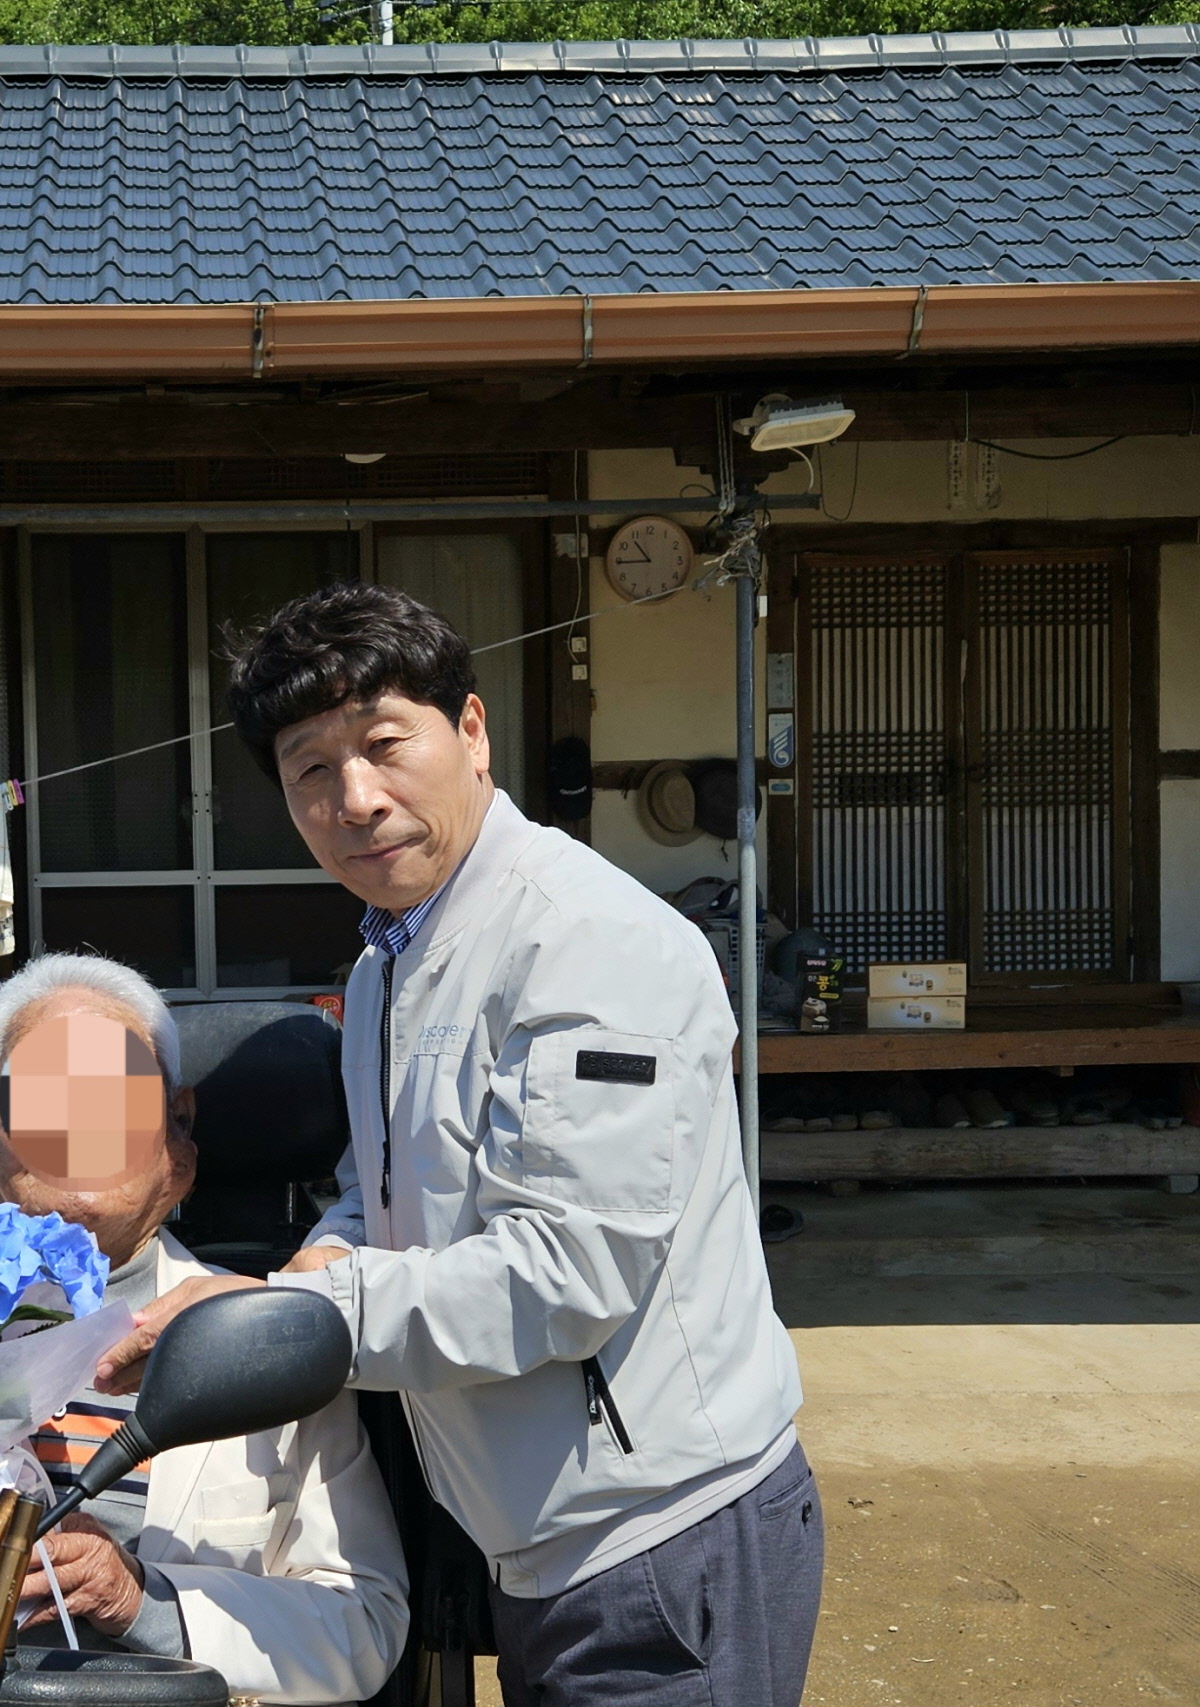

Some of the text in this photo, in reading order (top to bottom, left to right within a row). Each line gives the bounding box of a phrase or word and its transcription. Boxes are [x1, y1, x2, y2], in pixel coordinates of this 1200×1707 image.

[632, 530, 640, 539] 11
[646, 525, 655, 536] 12
[619, 541, 629, 551] 10
[673, 541, 679, 550] 2
[677, 556, 683, 565] 3
[619, 572, 626, 581] 8
[672, 571, 679, 580] 4
[631, 583, 637, 592] 7
[645, 586, 652, 596] 6
[661, 582, 668, 592] 5
